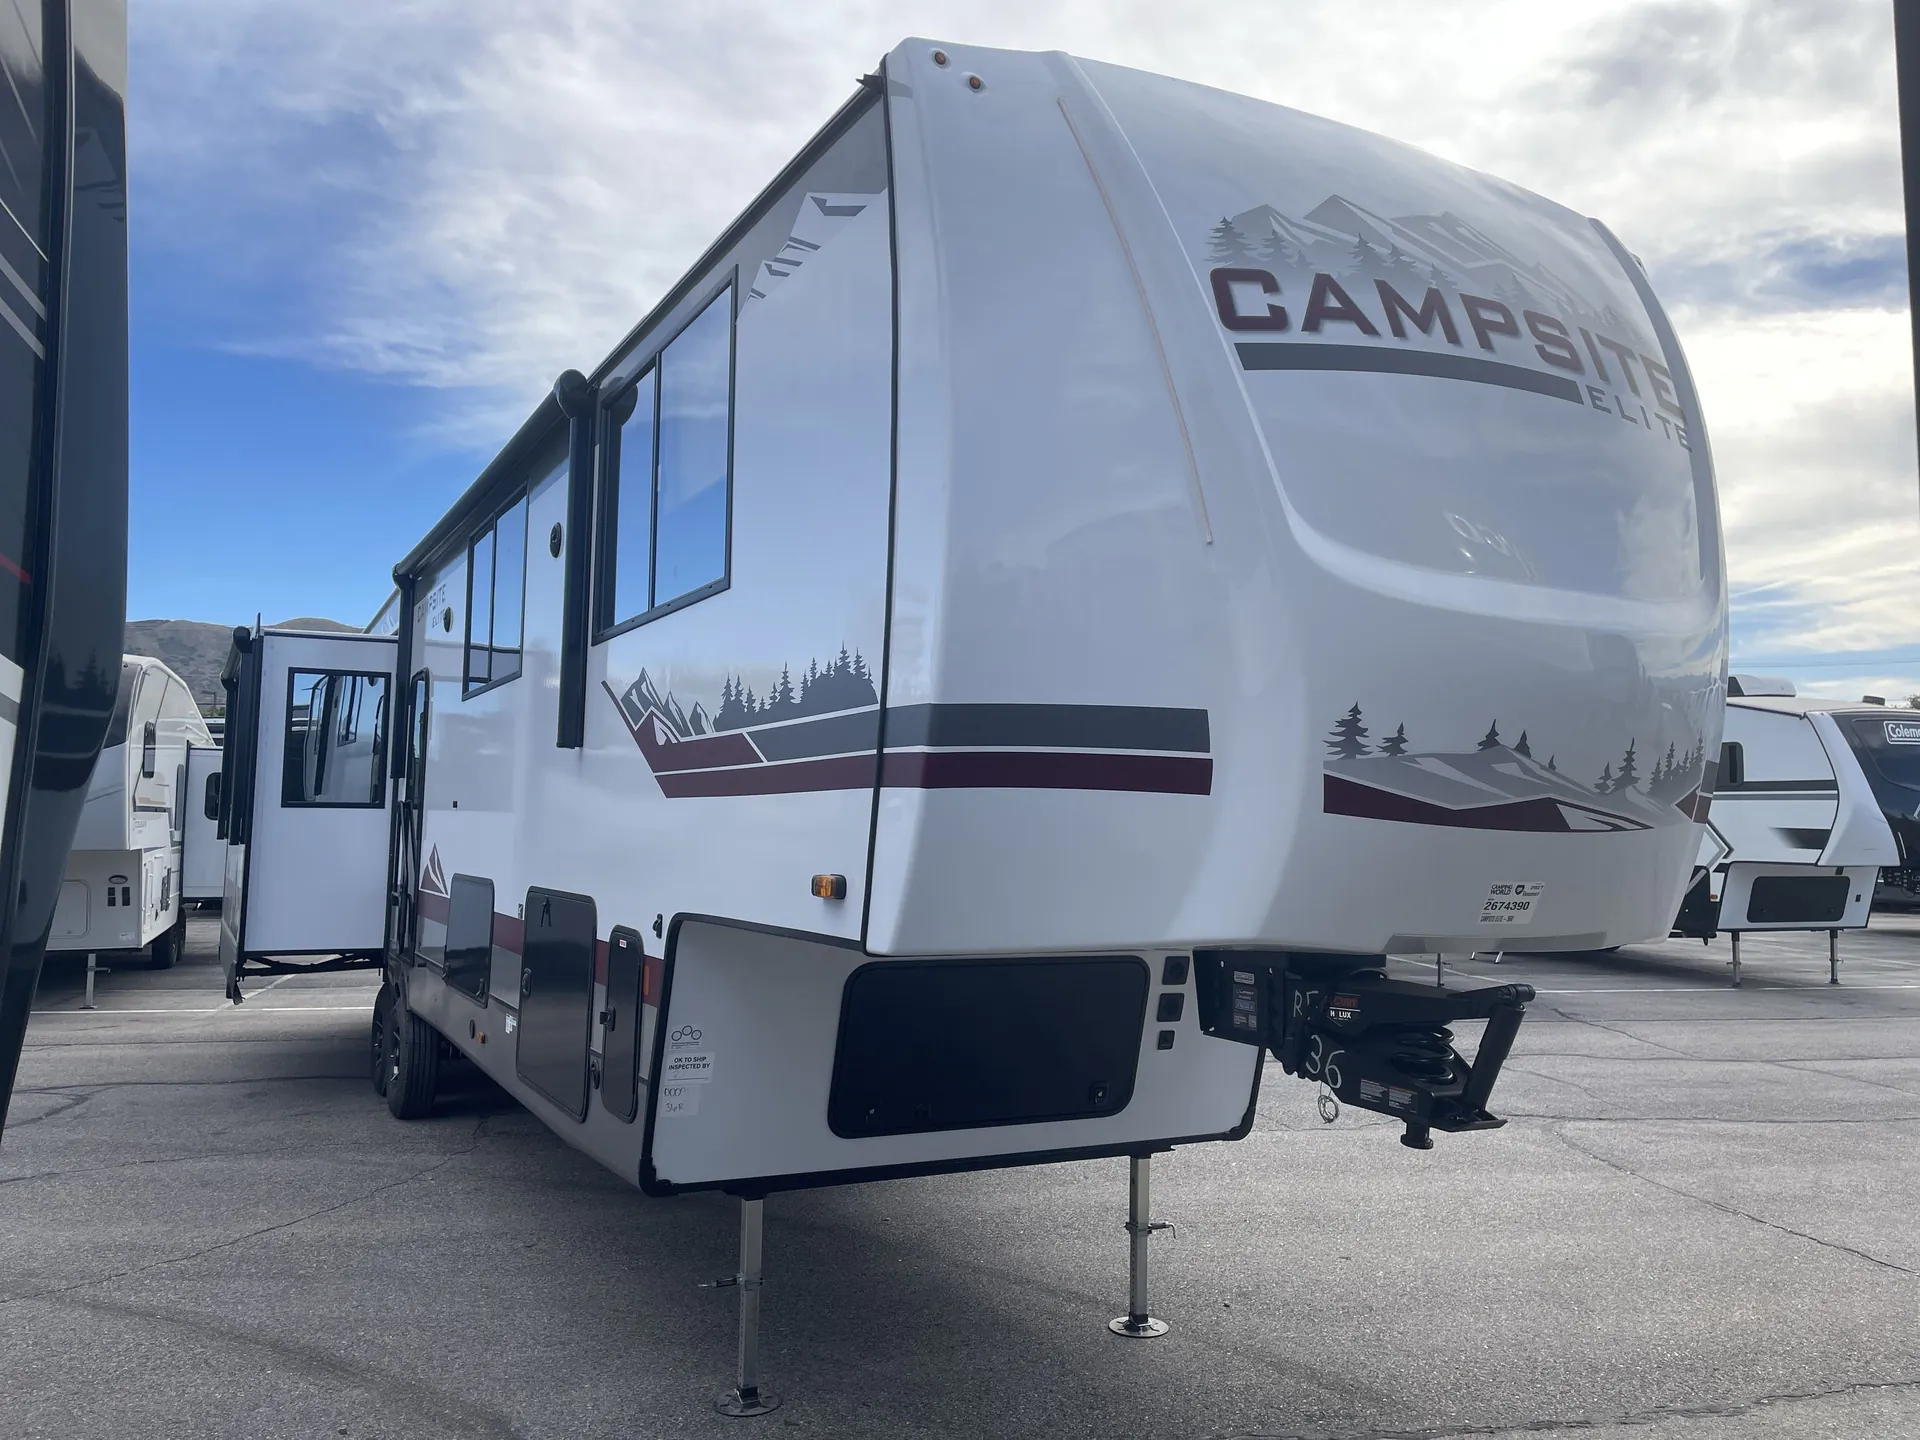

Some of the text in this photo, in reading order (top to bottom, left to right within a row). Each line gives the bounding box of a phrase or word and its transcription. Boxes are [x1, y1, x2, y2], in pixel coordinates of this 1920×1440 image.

[1209, 267, 1687, 423] CAMPSITE
[1585, 384, 1693, 454] ELITE
[1483, 901, 1530, 911] 2674390
[1330, 1010, 1352, 1019] HLUX
[1306, 1034, 1345, 1088] 36
